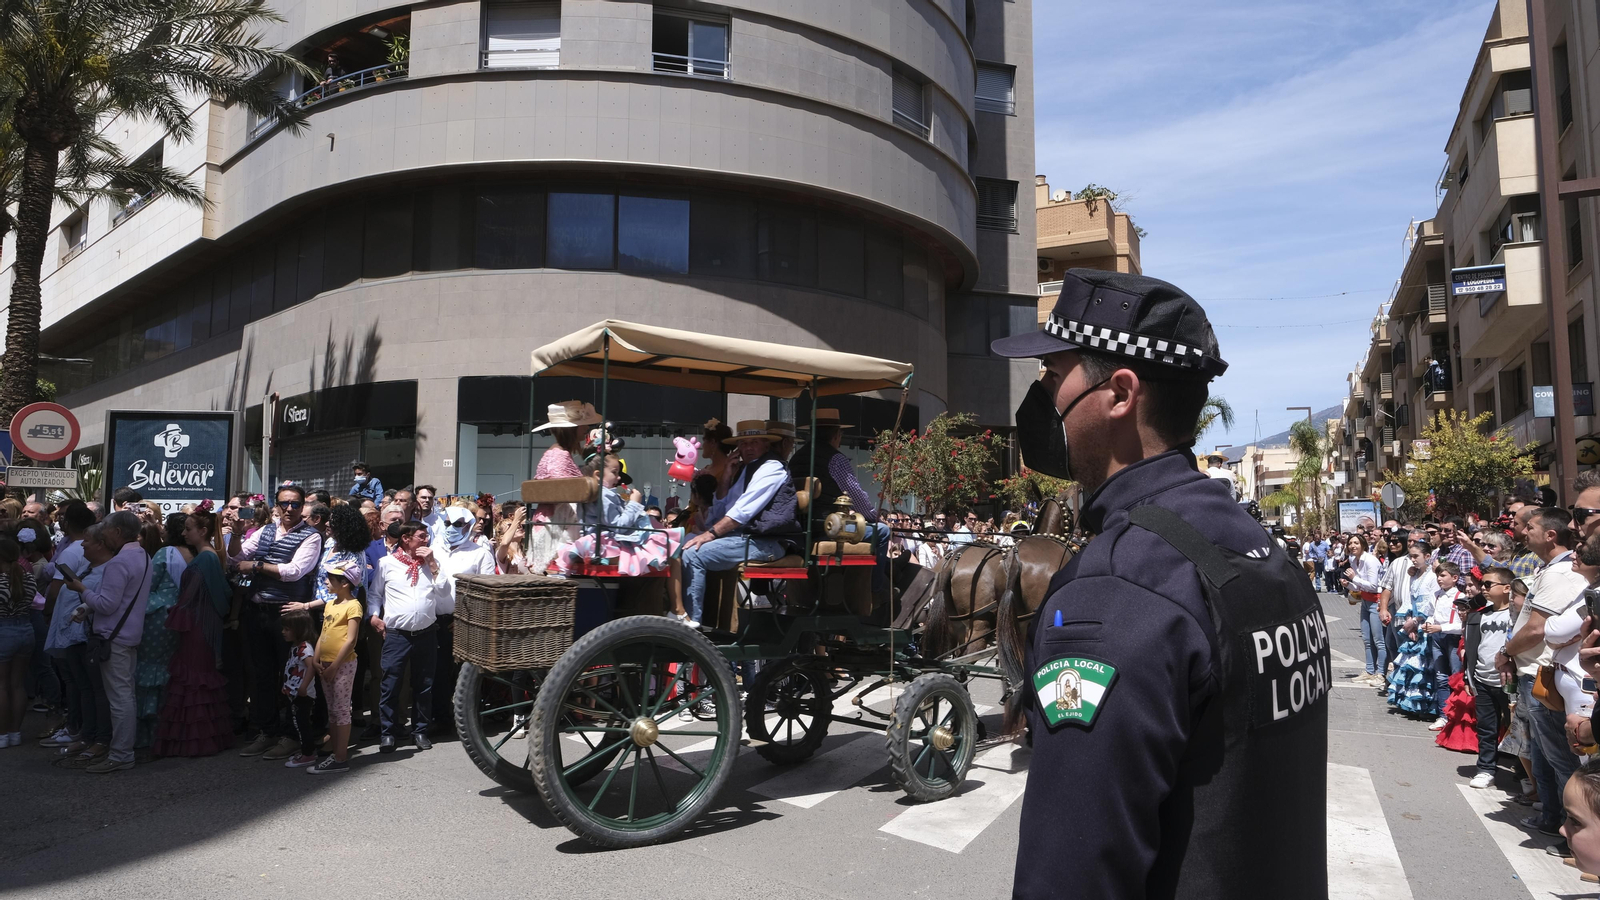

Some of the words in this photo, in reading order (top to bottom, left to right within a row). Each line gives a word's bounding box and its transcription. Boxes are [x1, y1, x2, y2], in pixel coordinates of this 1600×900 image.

[167, 461, 215, 470] Farmacia
[10, 469, 39, 477] EXCEPTO
[40, 471, 75, 479] VEHICULOS
[127, 459, 215, 490] Bulevar
[20, 478, 65, 486] AUTORIZADOS
[1037, 660, 1071, 679] POLICIA
[1074, 660, 1105, 674] LOCAL
[1271, 655, 1330, 721] LOCAL
